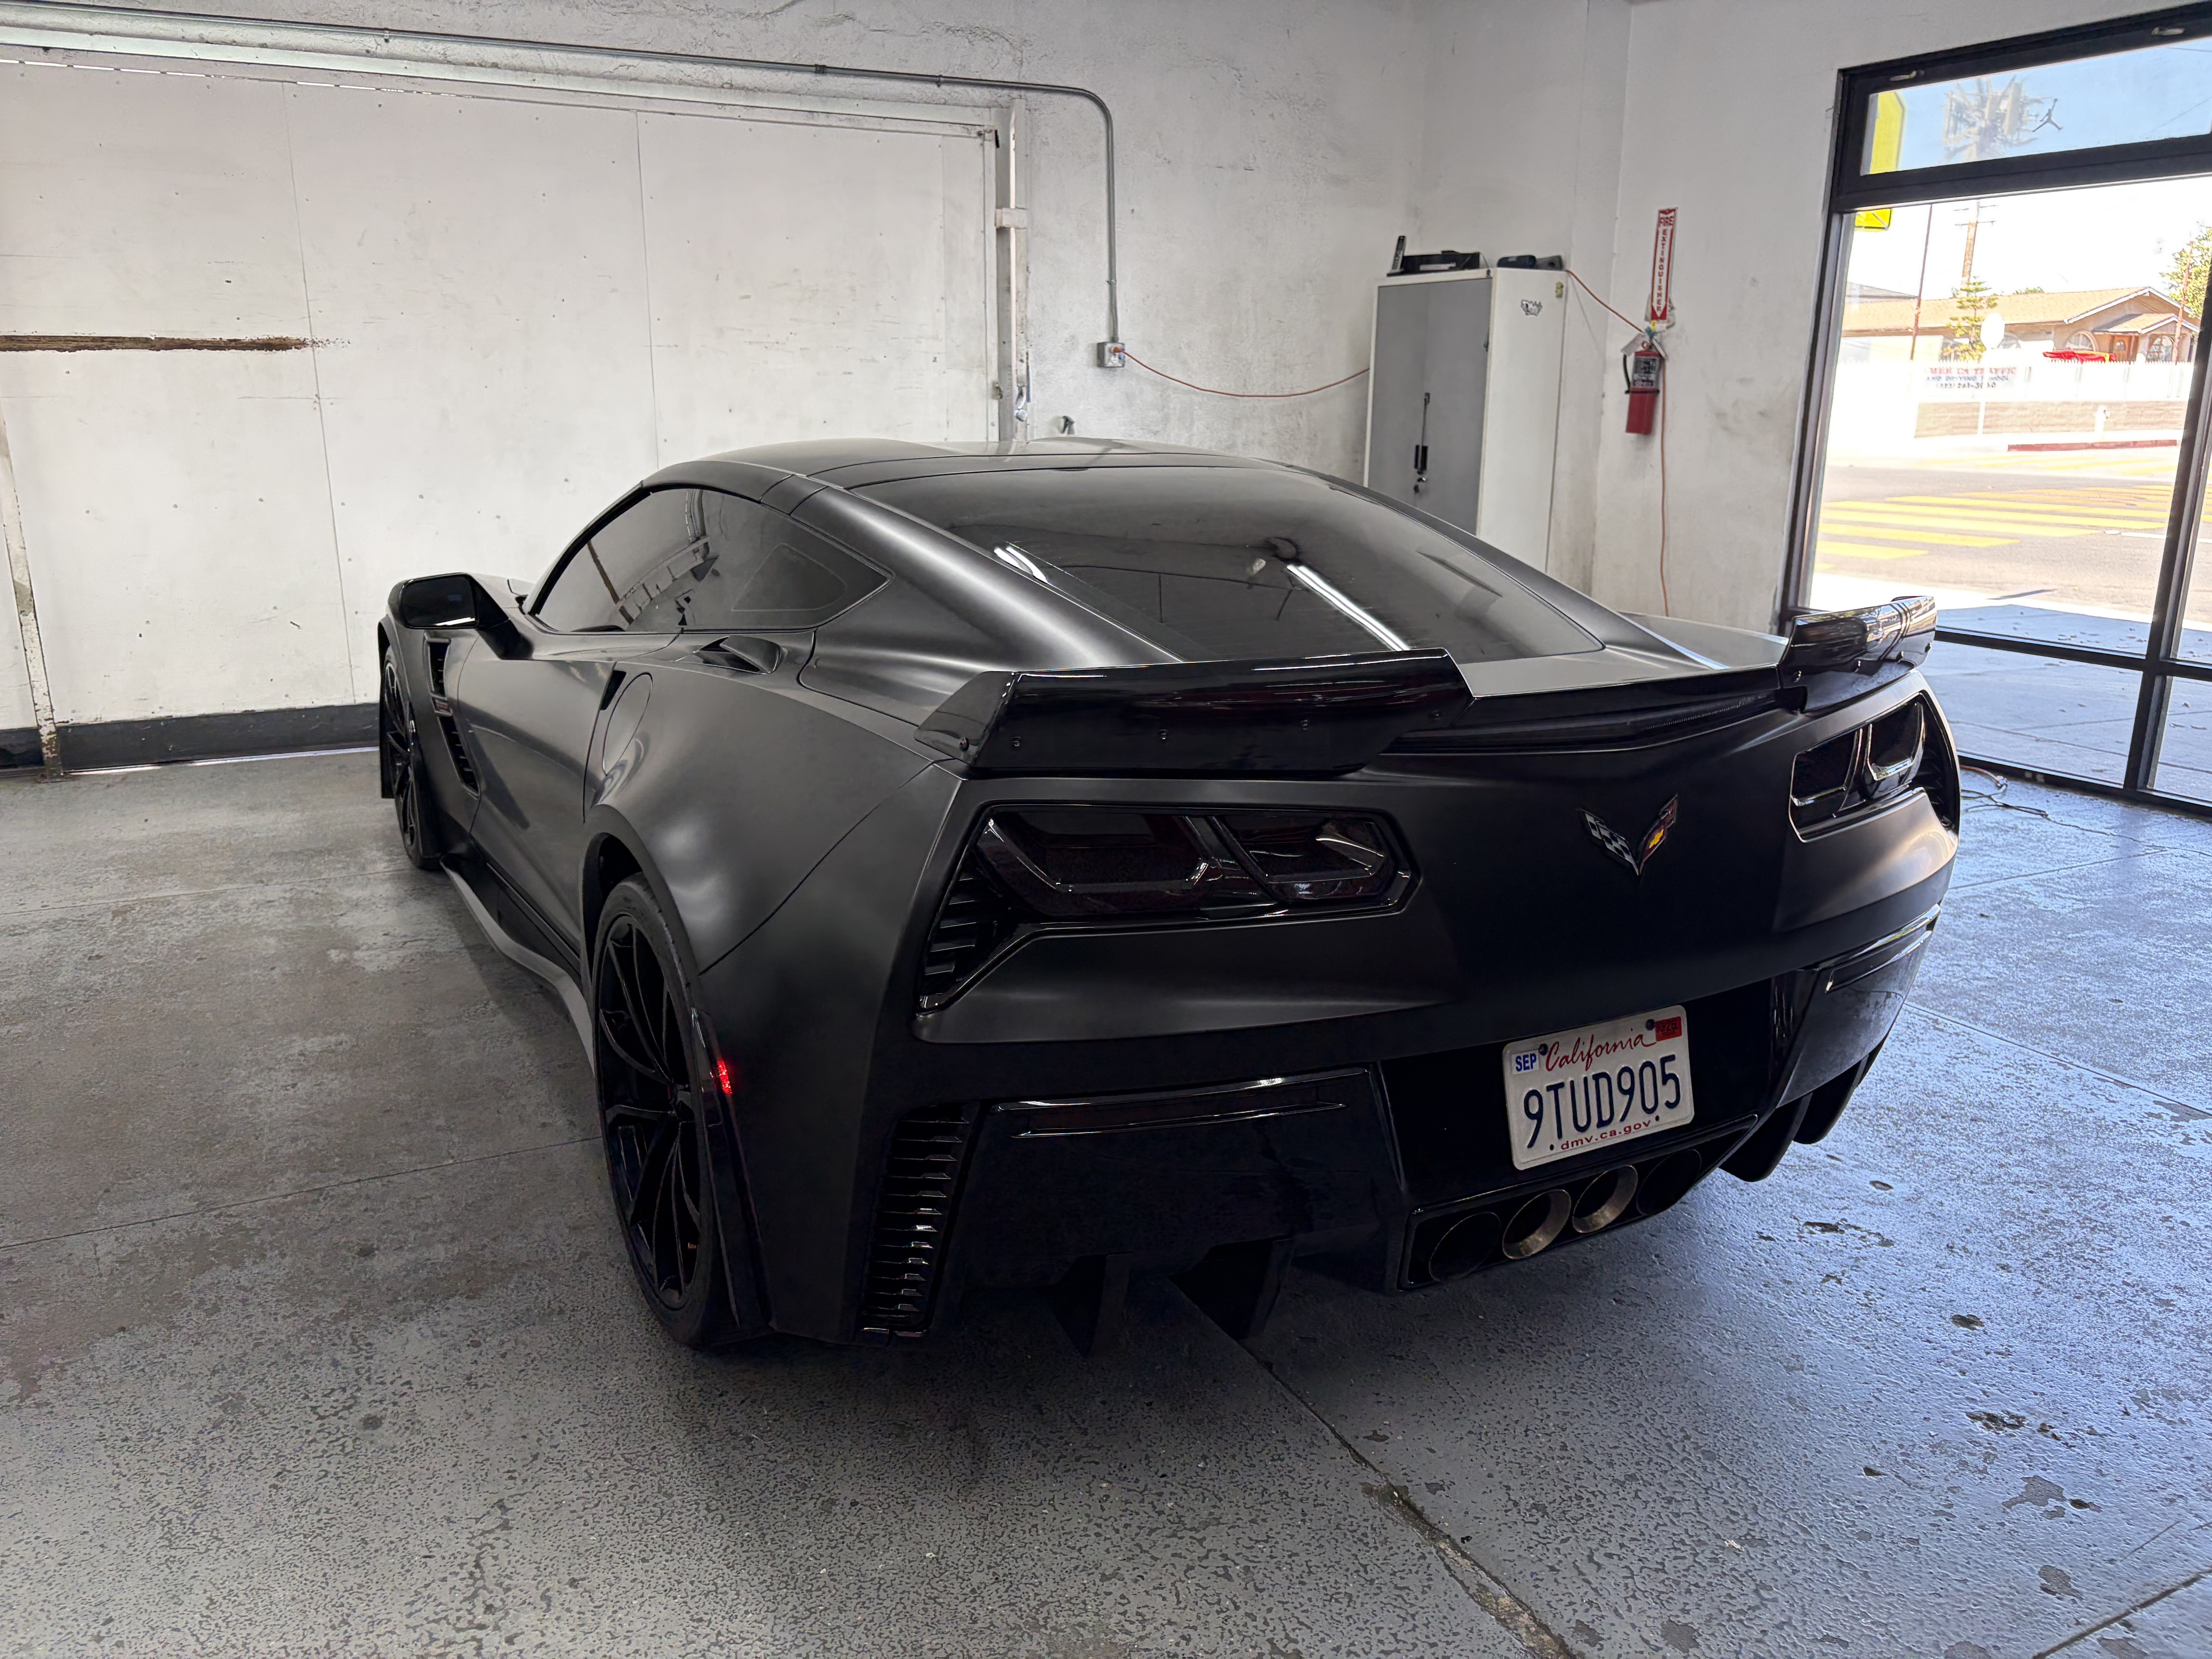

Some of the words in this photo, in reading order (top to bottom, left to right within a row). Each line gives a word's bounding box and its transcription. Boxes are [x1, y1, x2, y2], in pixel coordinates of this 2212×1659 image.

[1656, 229, 1668, 312] EXTINGUISHER
[1515, 1053, 1537, 1072] SEP
[1546, 1028, 1657, 1072] California
[1523, 1054, 1681, 1149] 9TUD905
[1561, 1120, 1651, 1151] dmv.ca.gov
